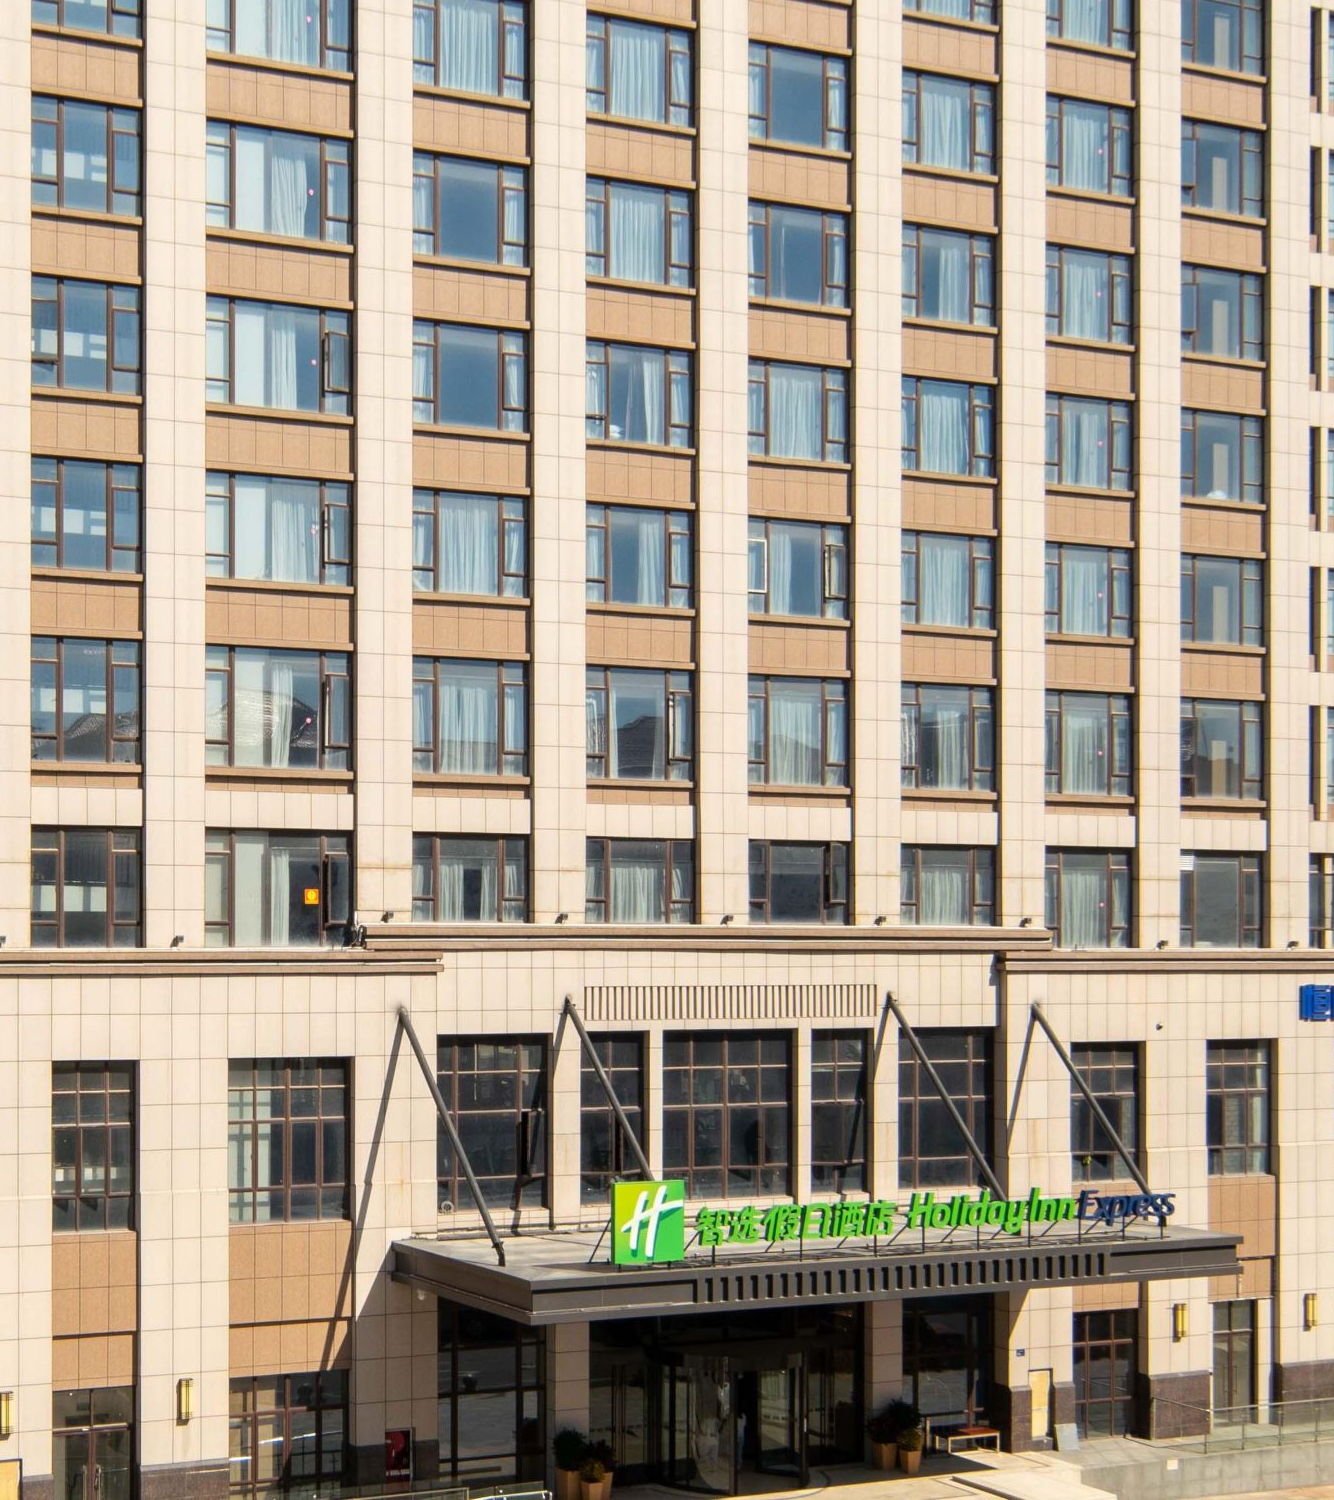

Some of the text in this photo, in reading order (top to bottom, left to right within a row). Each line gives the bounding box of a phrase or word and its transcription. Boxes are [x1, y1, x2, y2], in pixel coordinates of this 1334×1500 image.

[696, 1200, 897, 1246] 智选假日酒店
[1077, 1190, 1177, 1227] Express
